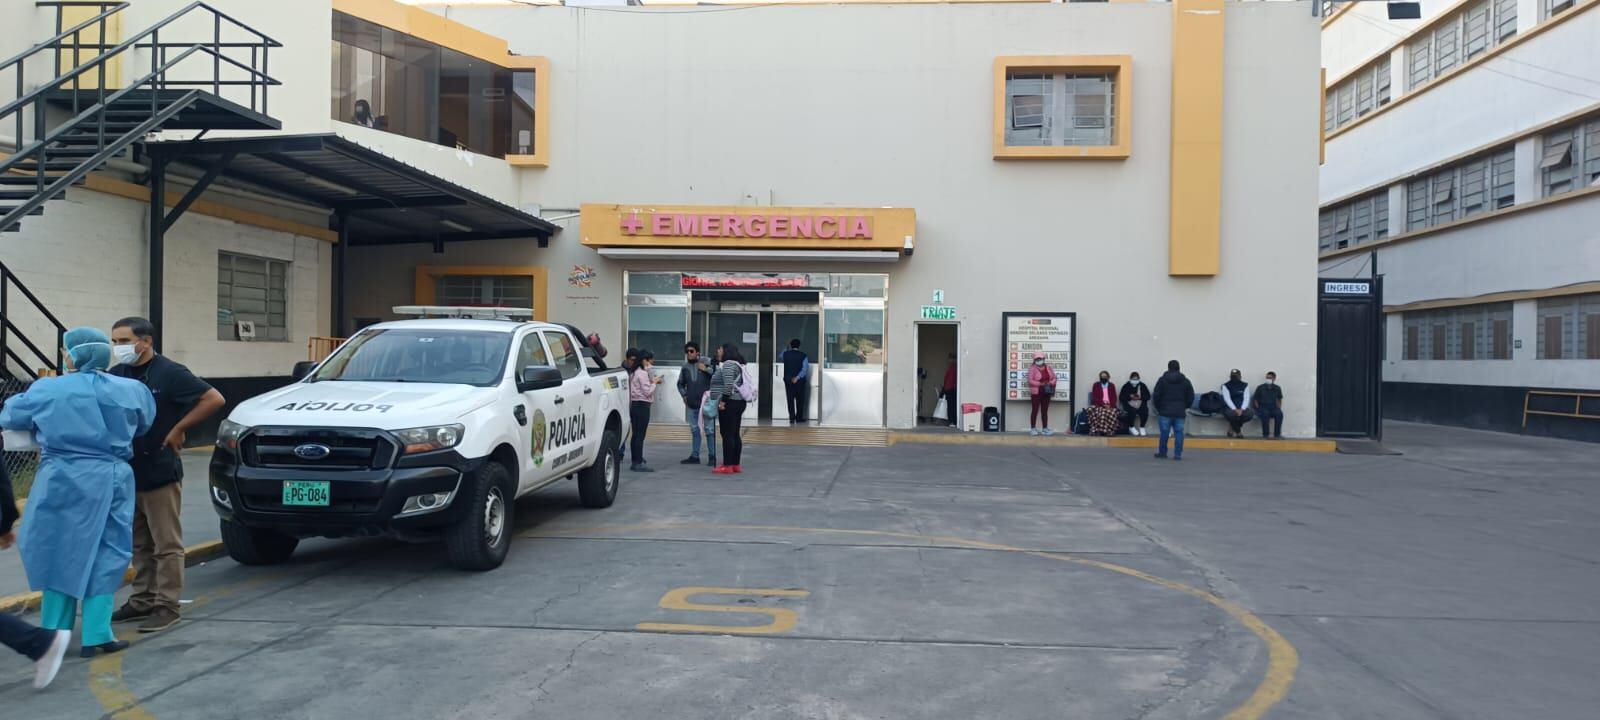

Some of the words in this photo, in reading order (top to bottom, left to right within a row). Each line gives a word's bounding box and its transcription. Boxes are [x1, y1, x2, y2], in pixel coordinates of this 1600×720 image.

[652, 213, 874, 240] EMERGENCIA
[934, 290, 941, 302] 1
[1327, 284, 1368, 292] INGRESO
[548, 406, 586, 451] POLICÍA
[291, 487, 327, 502] PG-084
[635, 586, 811, 634] S
